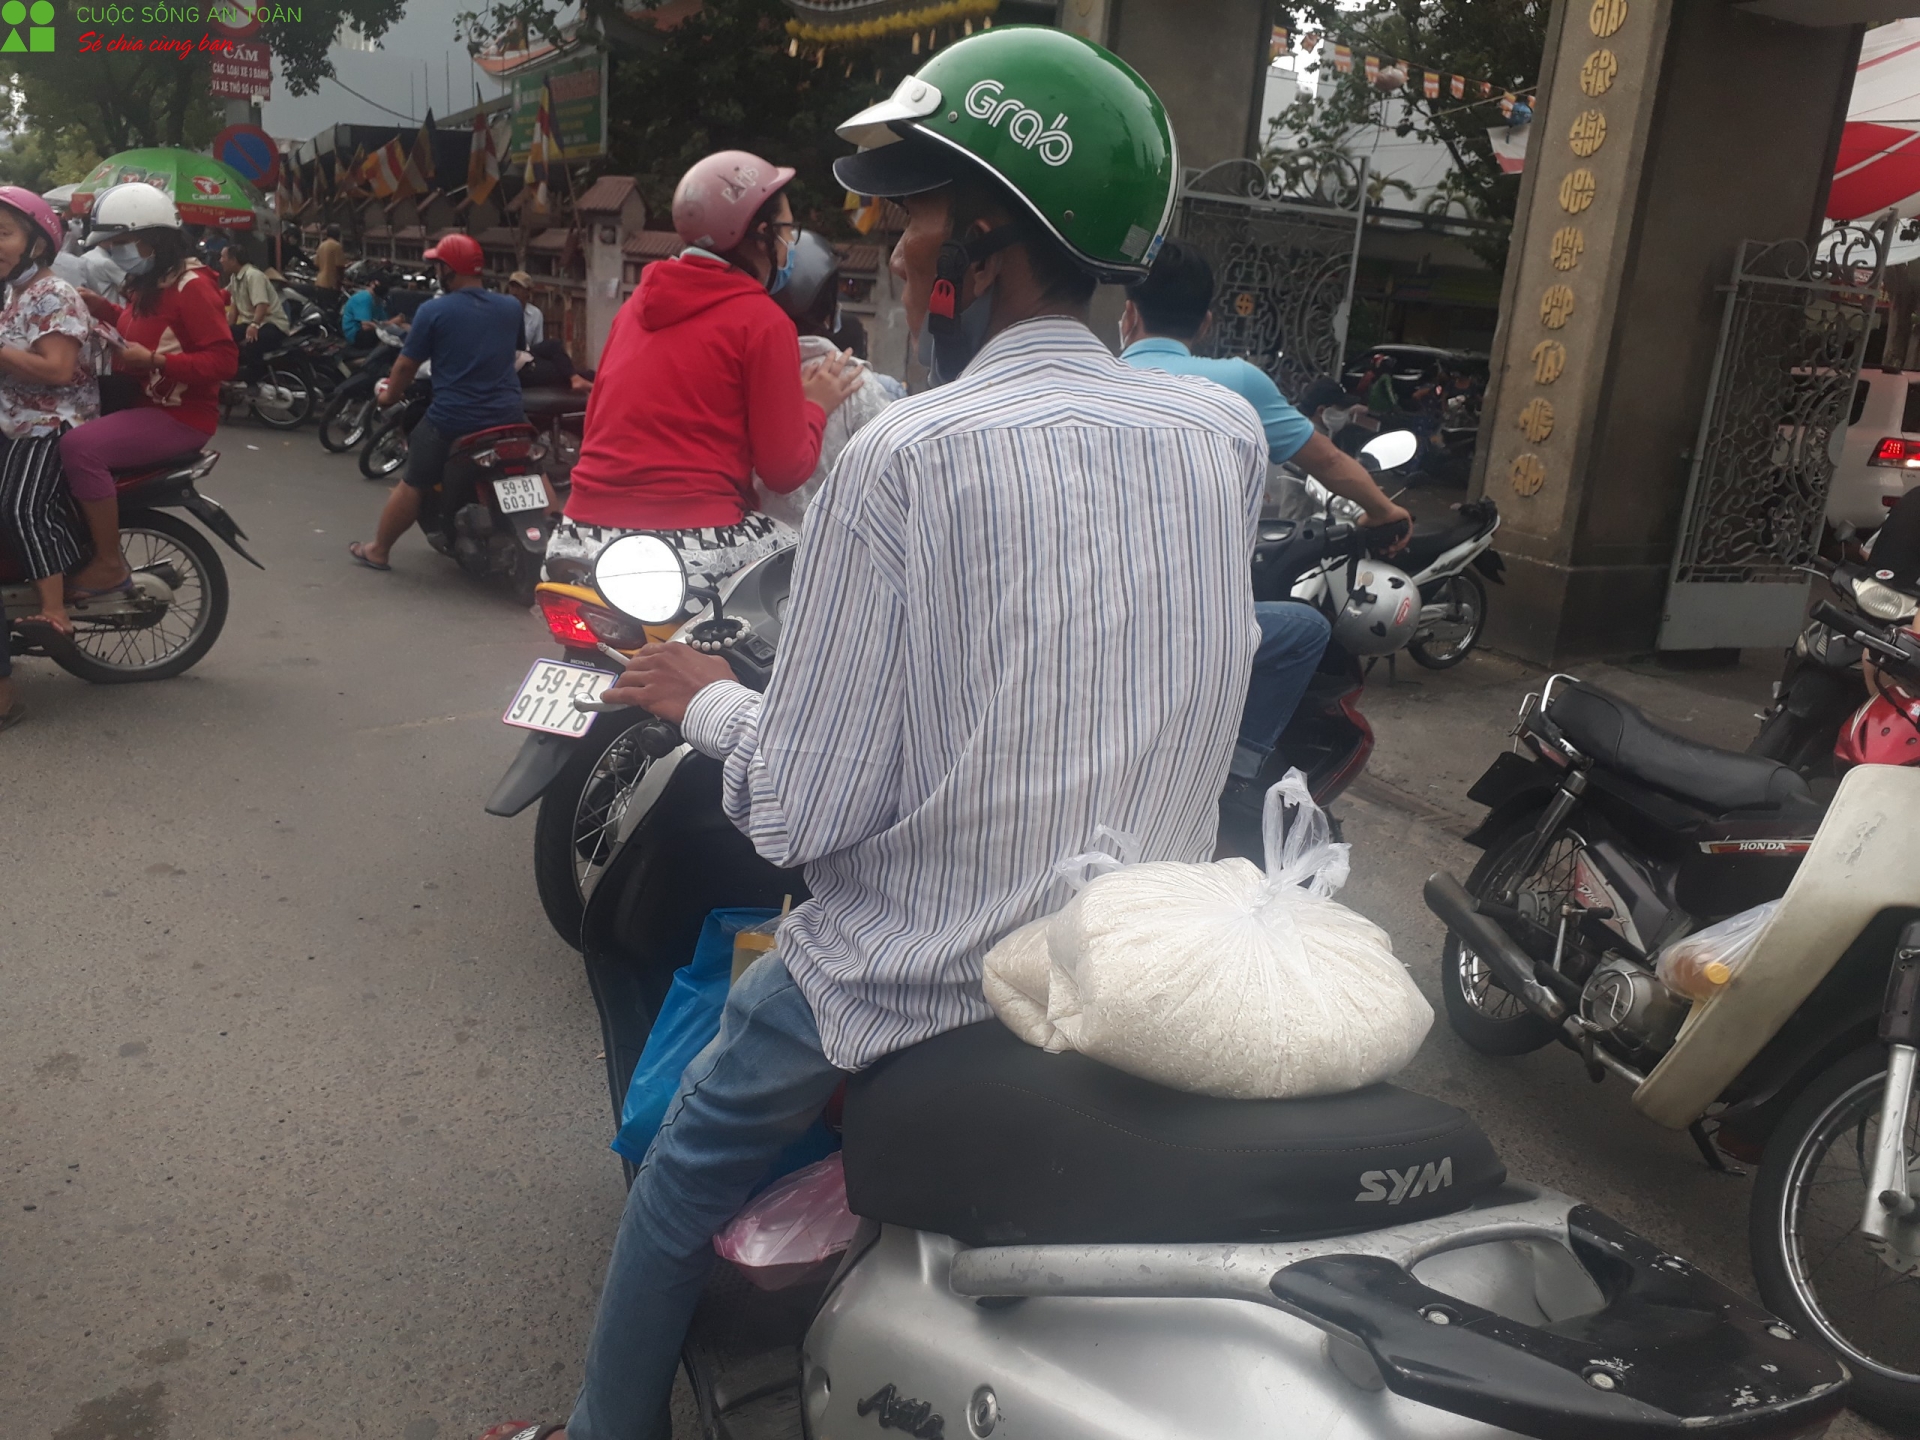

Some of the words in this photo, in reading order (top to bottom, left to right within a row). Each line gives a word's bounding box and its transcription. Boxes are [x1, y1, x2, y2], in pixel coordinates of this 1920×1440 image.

[222, 43, 259, 62] CẤM
[212, 61, 225, 74] CÁC
[965, 79, 1073, 167] Grab
[502, 479, 535, 496] 59-B1
[502, 491, 545, 511] 603.74
[570, 658, 595, 668] HONDA
[536, 666, 600, 699] 59-E1
[1739, 842, 1787, 851] HONDA
[1354, 1156, 1453, 1206] SYM
